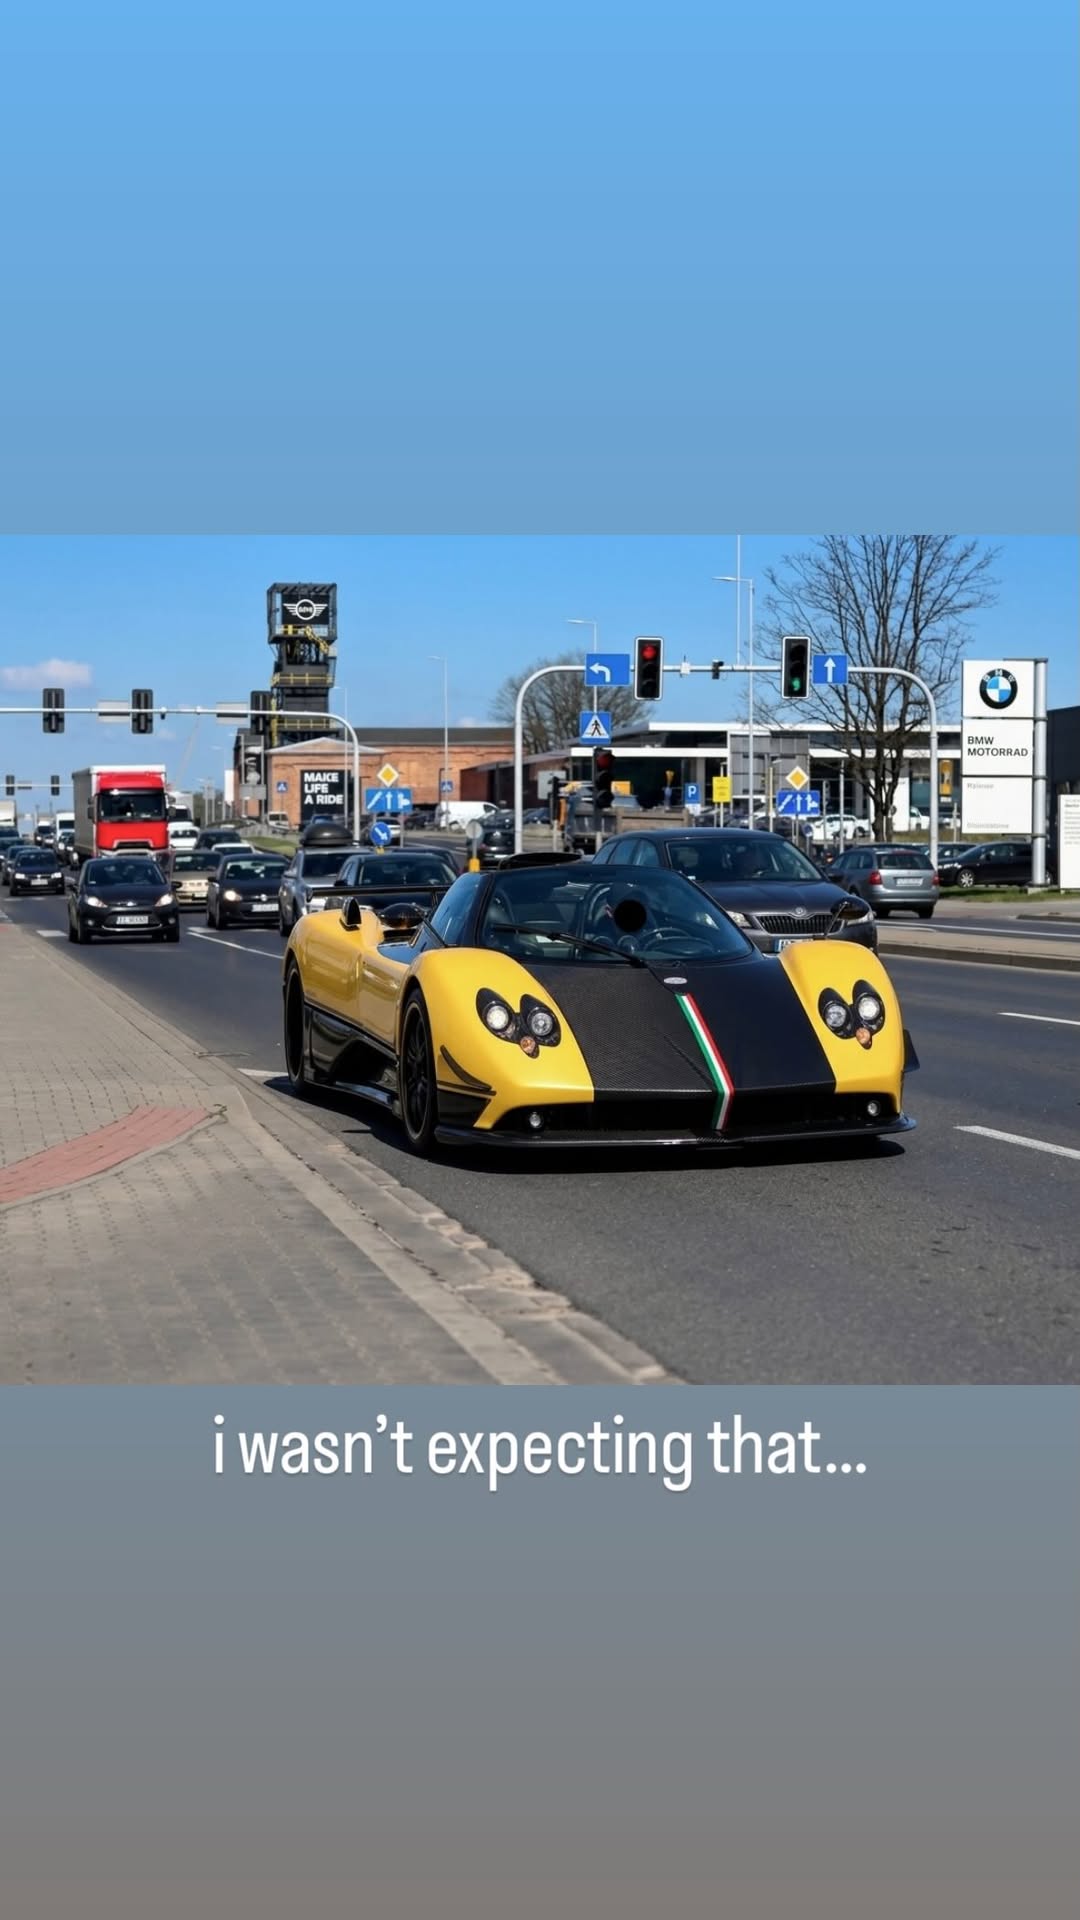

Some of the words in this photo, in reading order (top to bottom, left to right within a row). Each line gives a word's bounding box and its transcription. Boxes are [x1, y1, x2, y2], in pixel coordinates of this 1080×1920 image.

[967, 736, 994, 745] BMW
[967, 748, 1029, 757] MOTORRAD
[304, 772, 339, 782] MAKE
[304, 783, 329, 794] LIFE
[688, 785, 697, 798] P
[304, 795, 314, 805] A
[316, 795, 344, 805] RIDE
